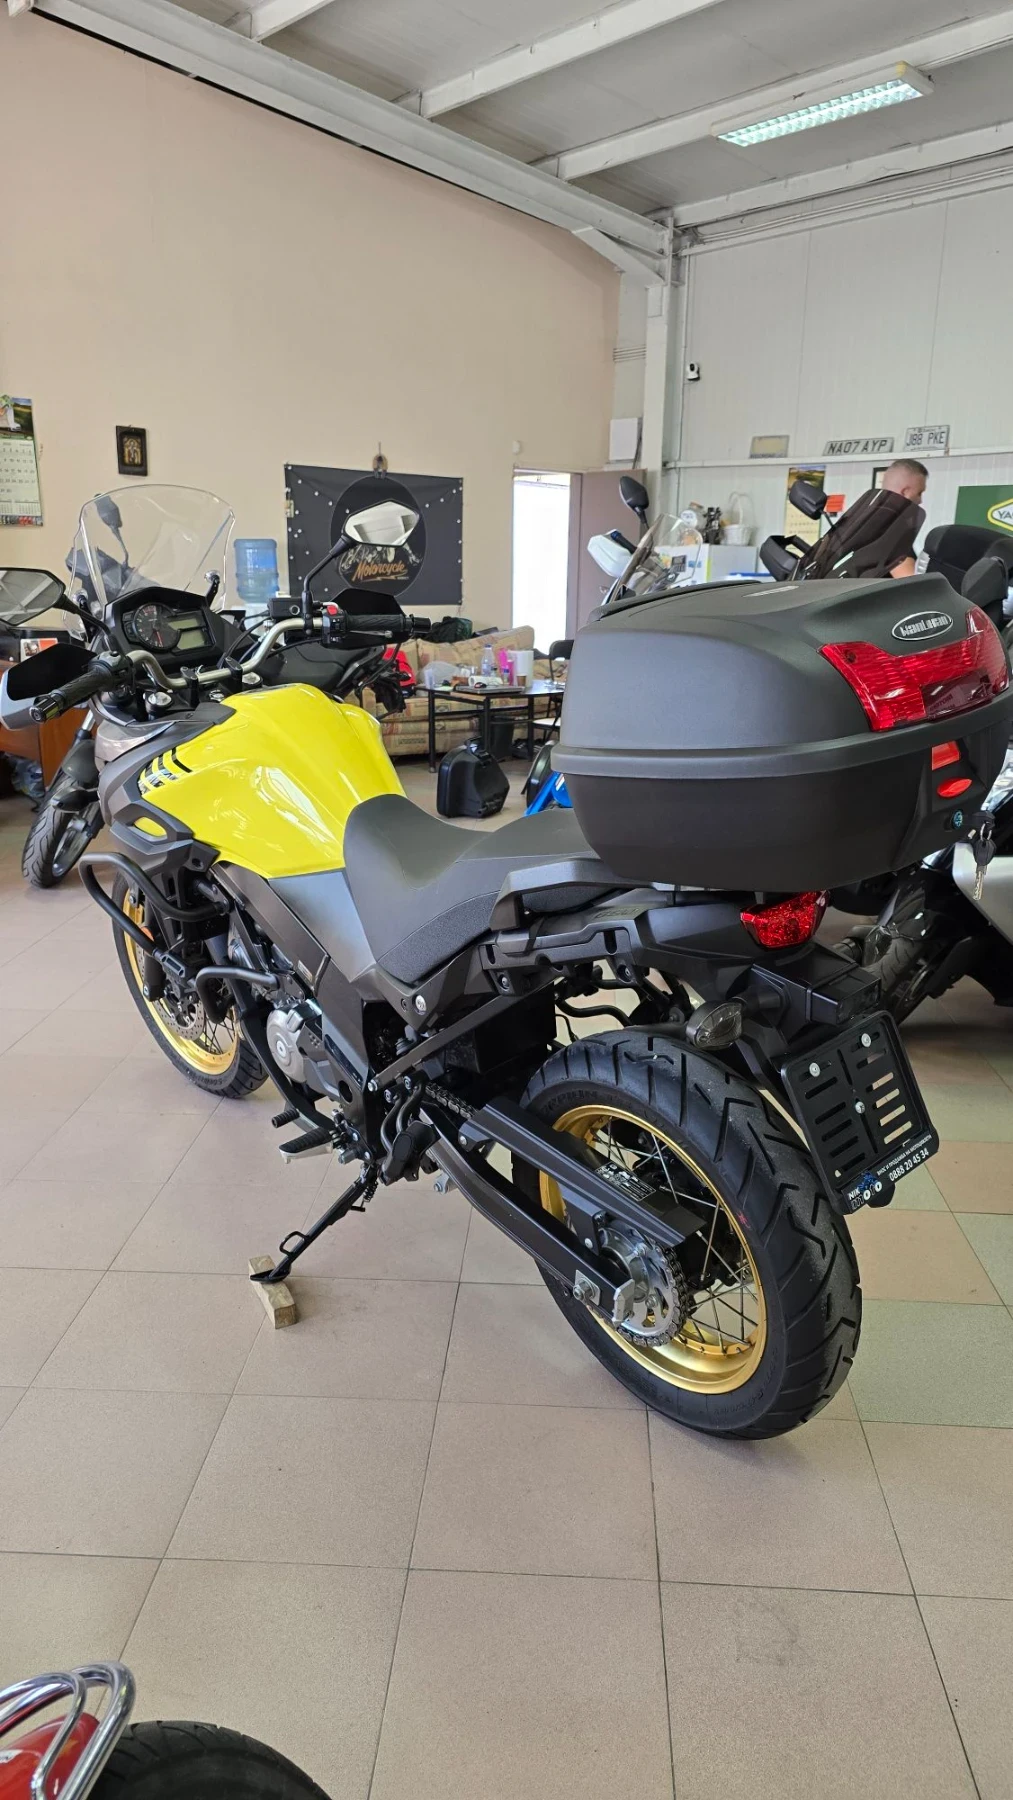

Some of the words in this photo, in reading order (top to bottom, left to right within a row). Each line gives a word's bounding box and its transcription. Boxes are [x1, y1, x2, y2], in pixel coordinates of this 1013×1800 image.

[828, 441, 861, 455] NA07
[861, 439, 888, 453] AYP
[905, 433, 923, 447] J88
[927, 431, 946, 445] PKE
[997, 510, 1013, 519] YA
[351, 560, 405, 582] Motorcycle
[888, 1164, 905, 1182] 0888
[904, 1160, 914, 1171] 20
[912, 1153, 921, 1164] 45
[920, 1147, 930, 1159] 34
[848, 1187, 861, 1200] NIK
